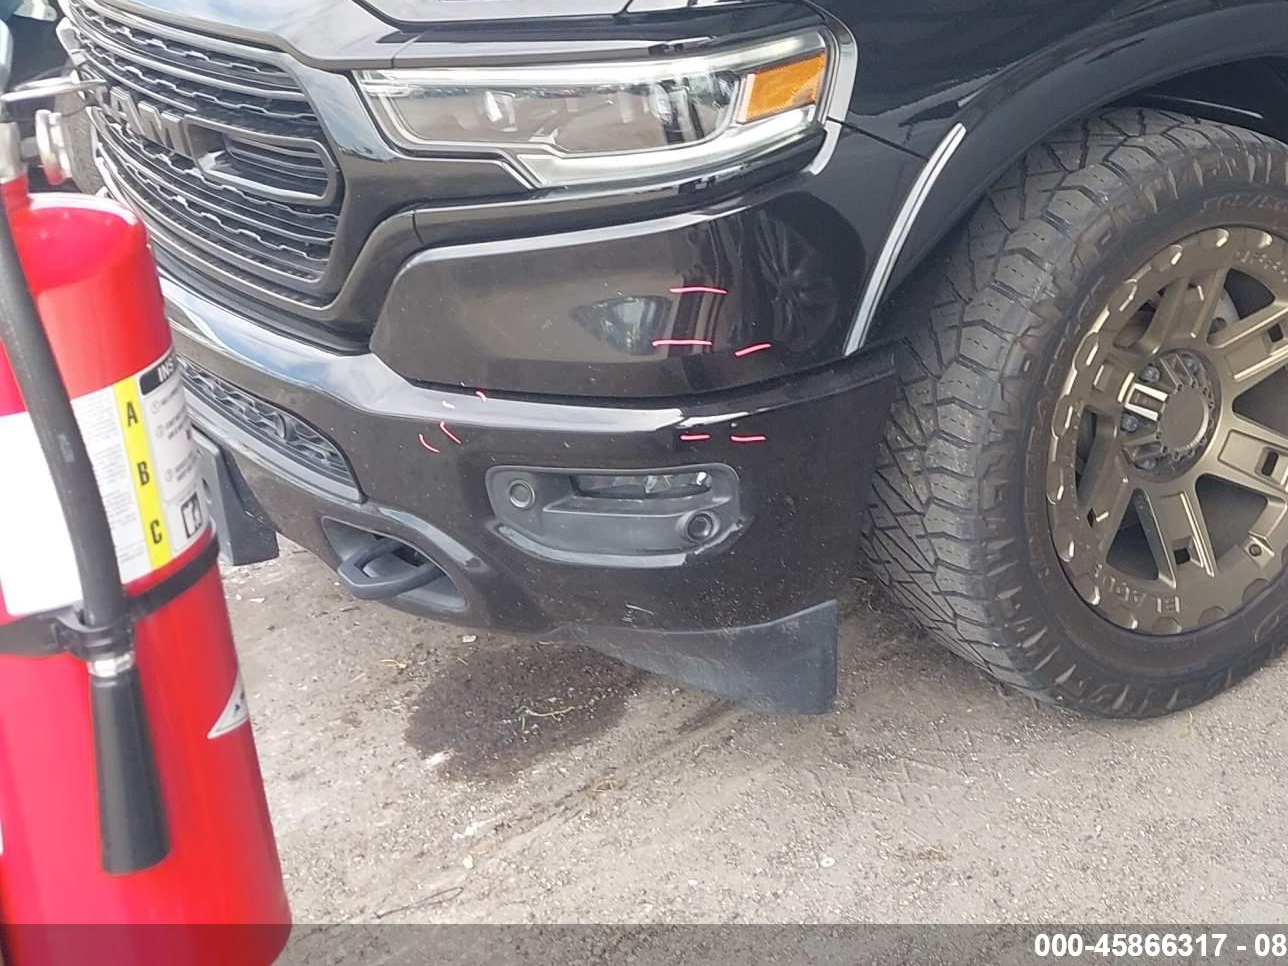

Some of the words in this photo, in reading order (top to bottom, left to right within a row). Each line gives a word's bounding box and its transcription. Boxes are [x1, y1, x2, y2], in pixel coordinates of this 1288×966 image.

[126, 402, 139, 427] A
[137, 461, 151, 486] B
[150, 519, 163, 545] C
